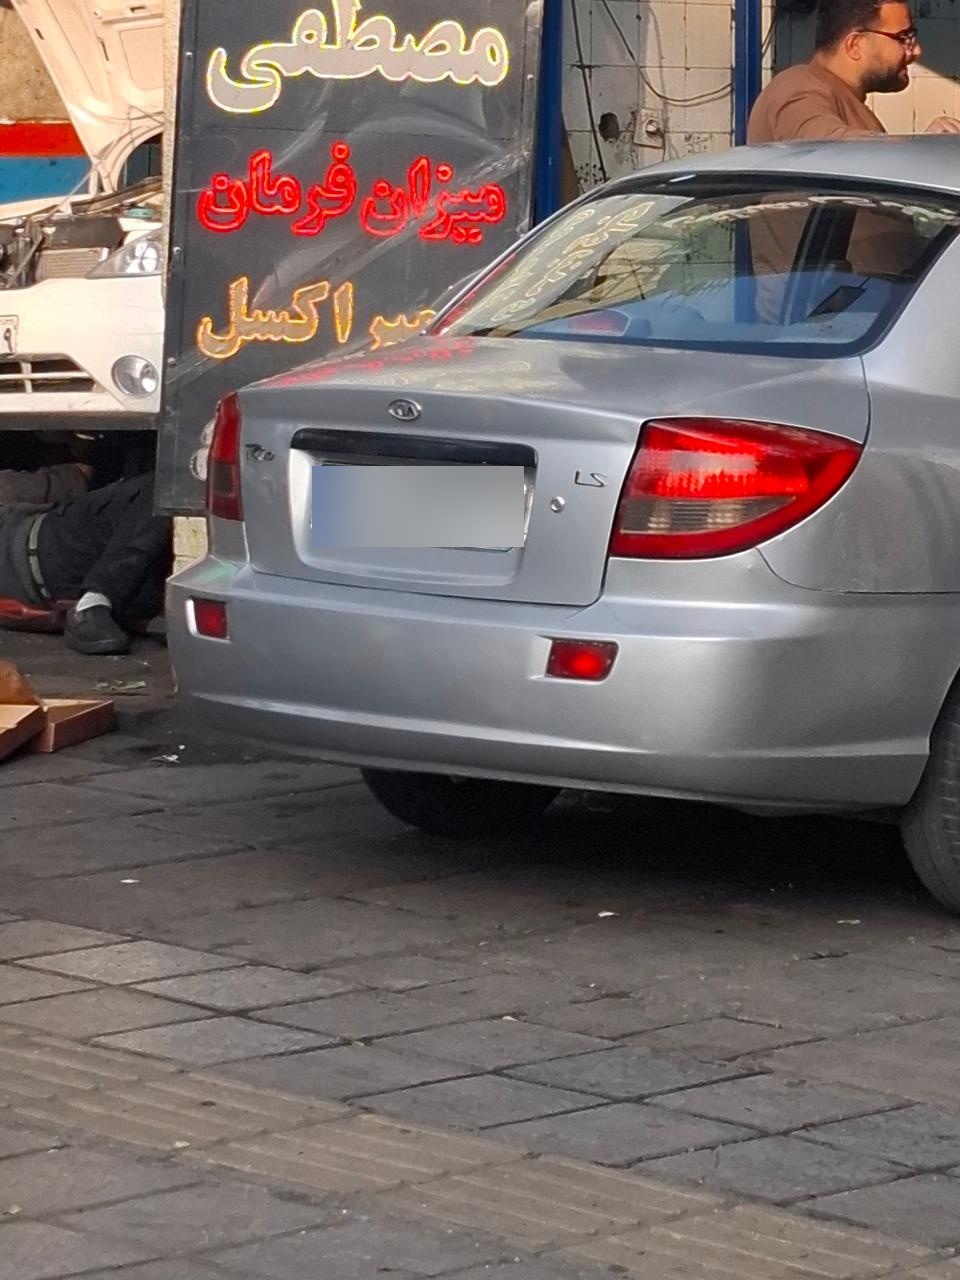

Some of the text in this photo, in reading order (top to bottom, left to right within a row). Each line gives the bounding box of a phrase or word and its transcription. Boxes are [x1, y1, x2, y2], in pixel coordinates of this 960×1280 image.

[197, 140, 507, 246] میزان فرمان
[197, 275, 355, 360] اکسل
[574, 469, 608, 488] LS
